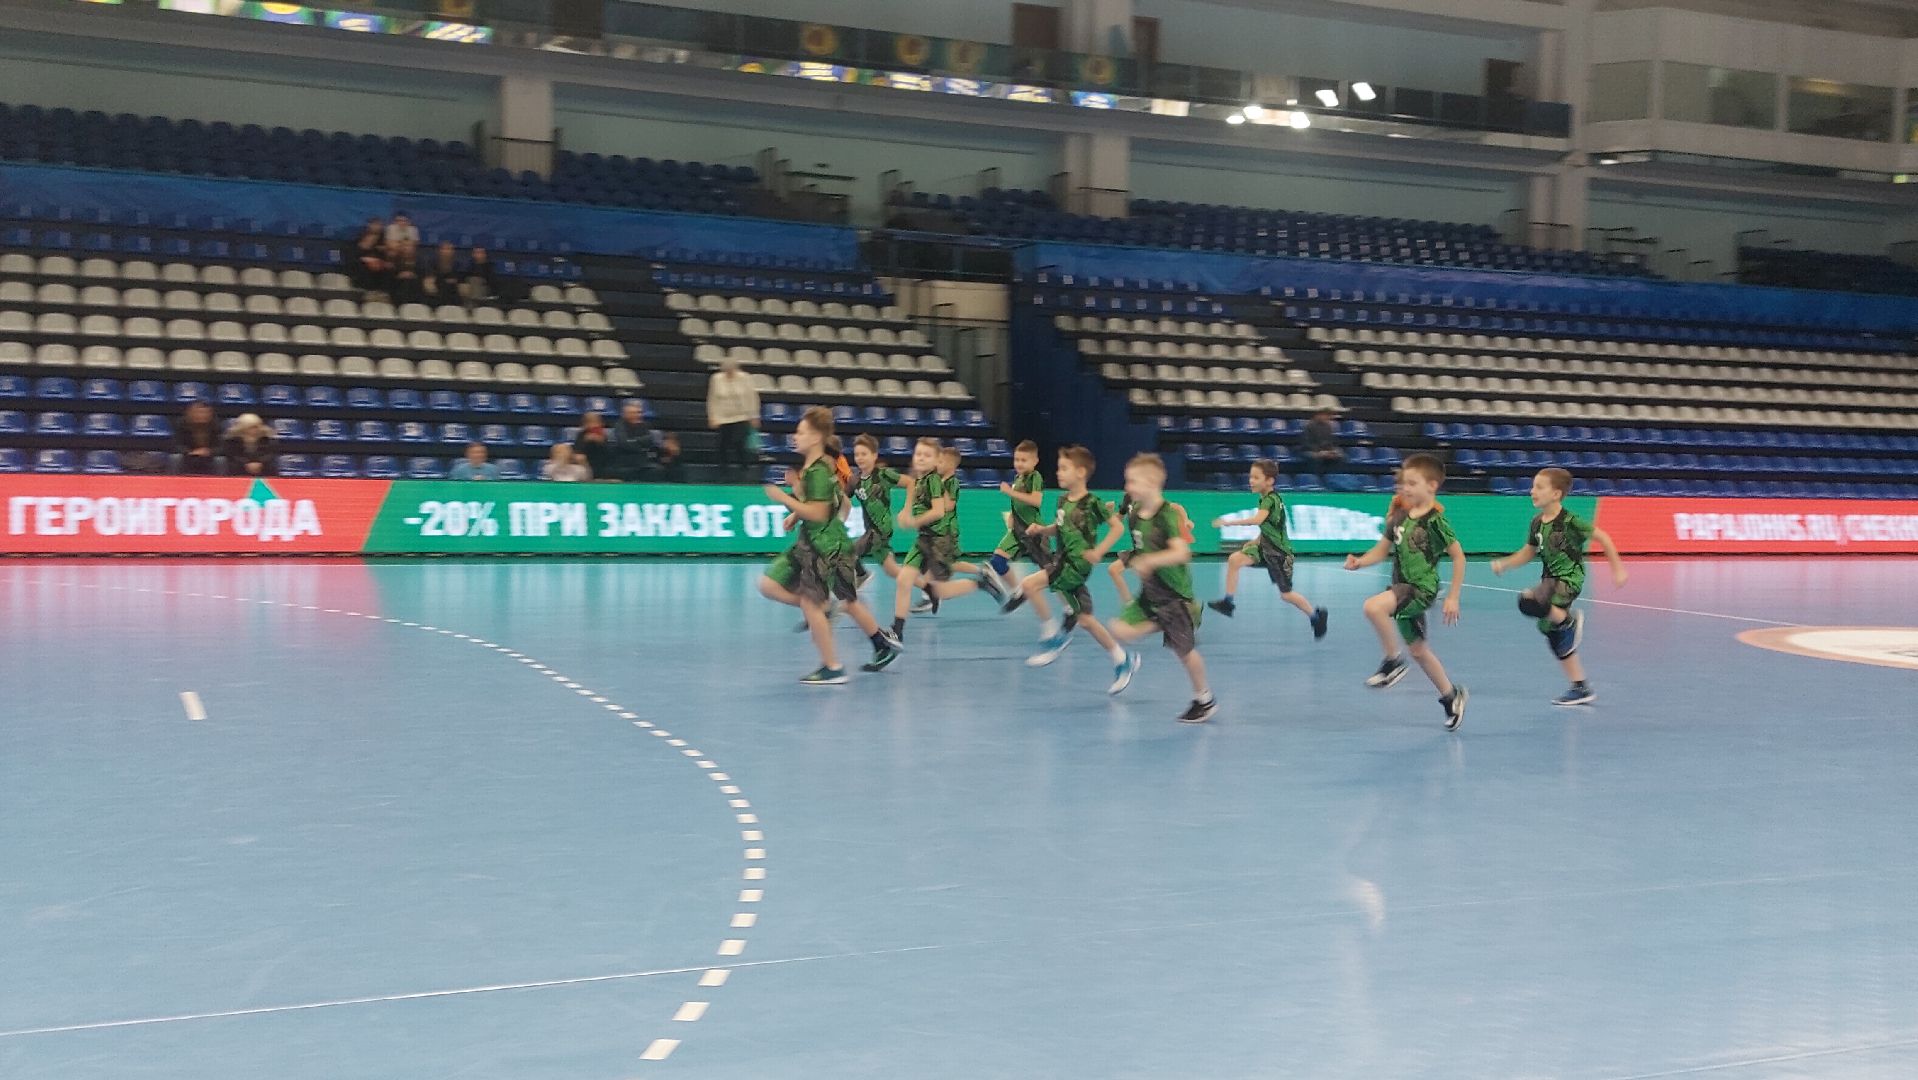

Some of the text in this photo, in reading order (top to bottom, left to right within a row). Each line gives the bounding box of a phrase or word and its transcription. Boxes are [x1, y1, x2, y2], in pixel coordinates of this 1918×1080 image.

[7, 496, 323, 541] ГЕРОИГОРОДА
[402, 501, 788, 538] -20% ПРИ ЗАКАЗЕ ОТ
